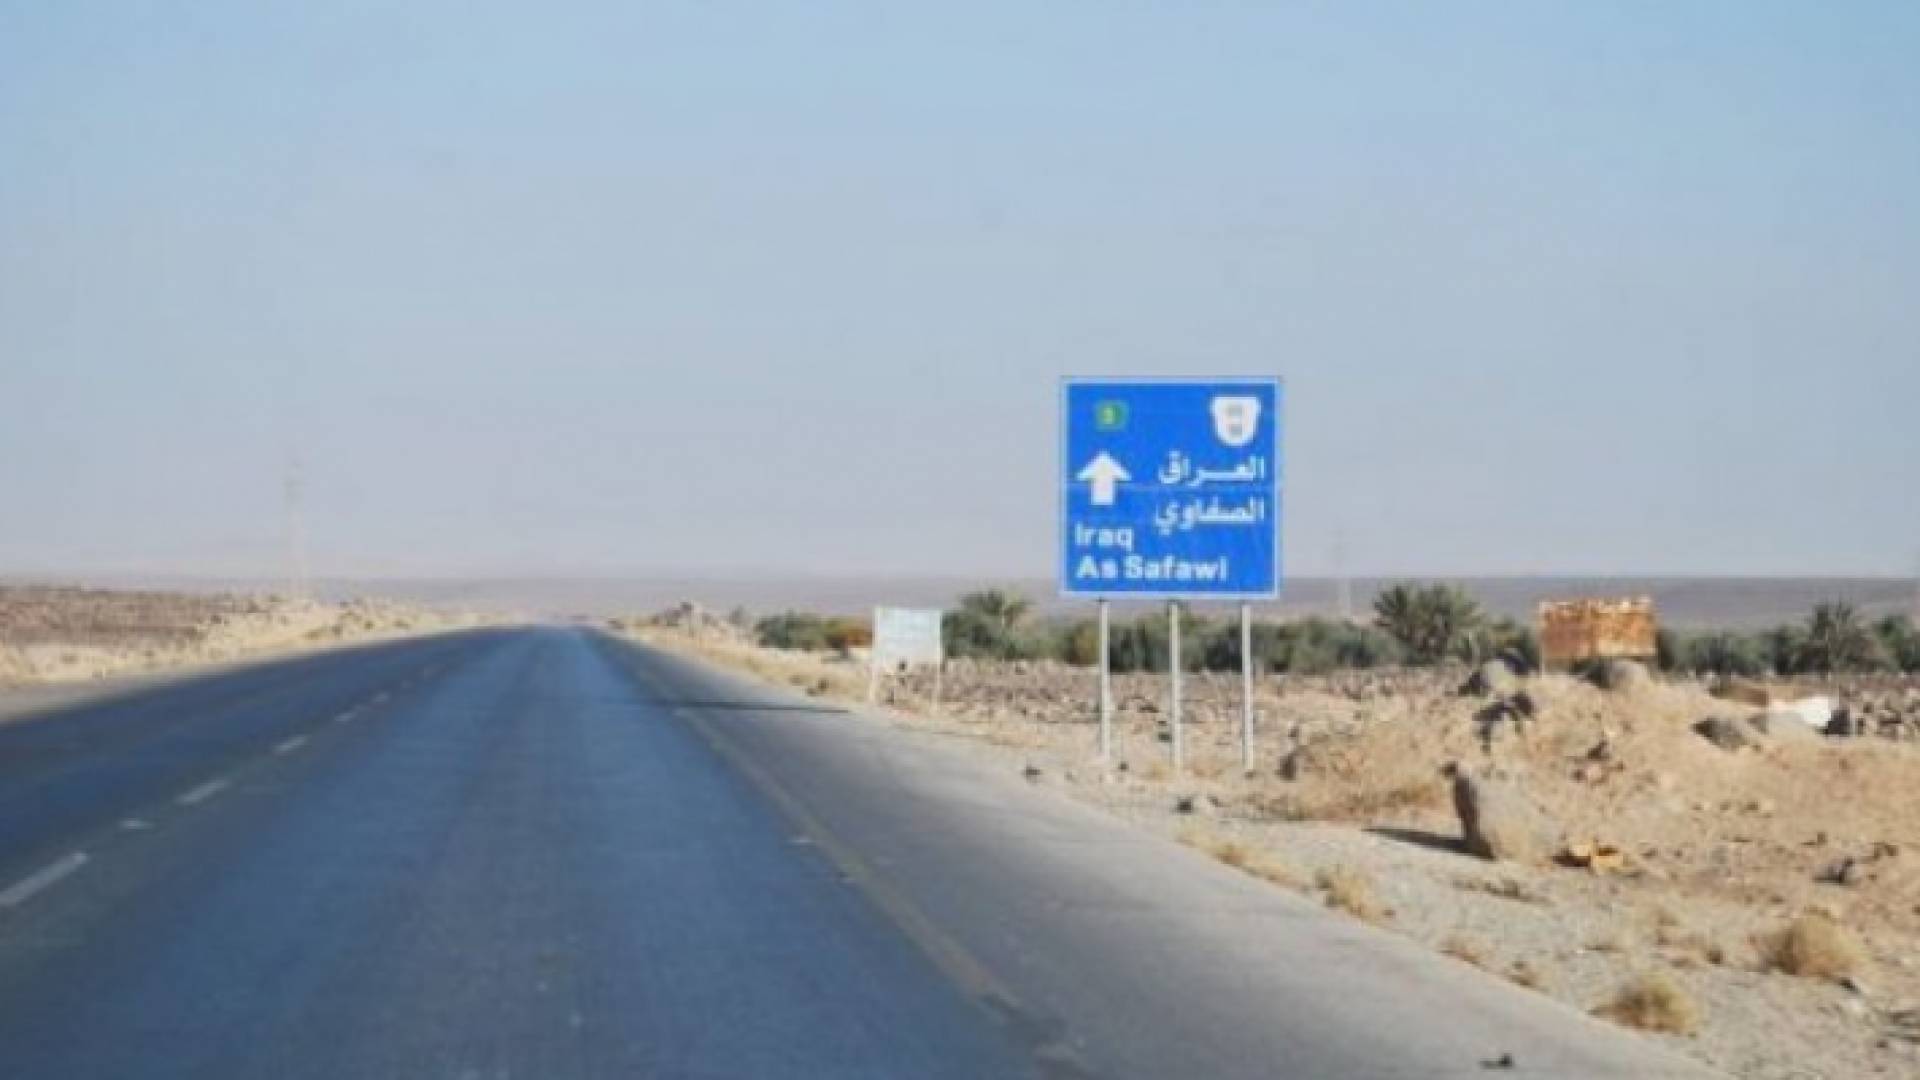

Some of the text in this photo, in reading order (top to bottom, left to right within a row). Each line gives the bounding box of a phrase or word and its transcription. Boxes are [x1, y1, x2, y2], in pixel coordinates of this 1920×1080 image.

[1158, 449, 1265, 486] العراق
[1074, 522, 1134, 552] Iraq
[1076, 554, 1228, 580] As Safawi
